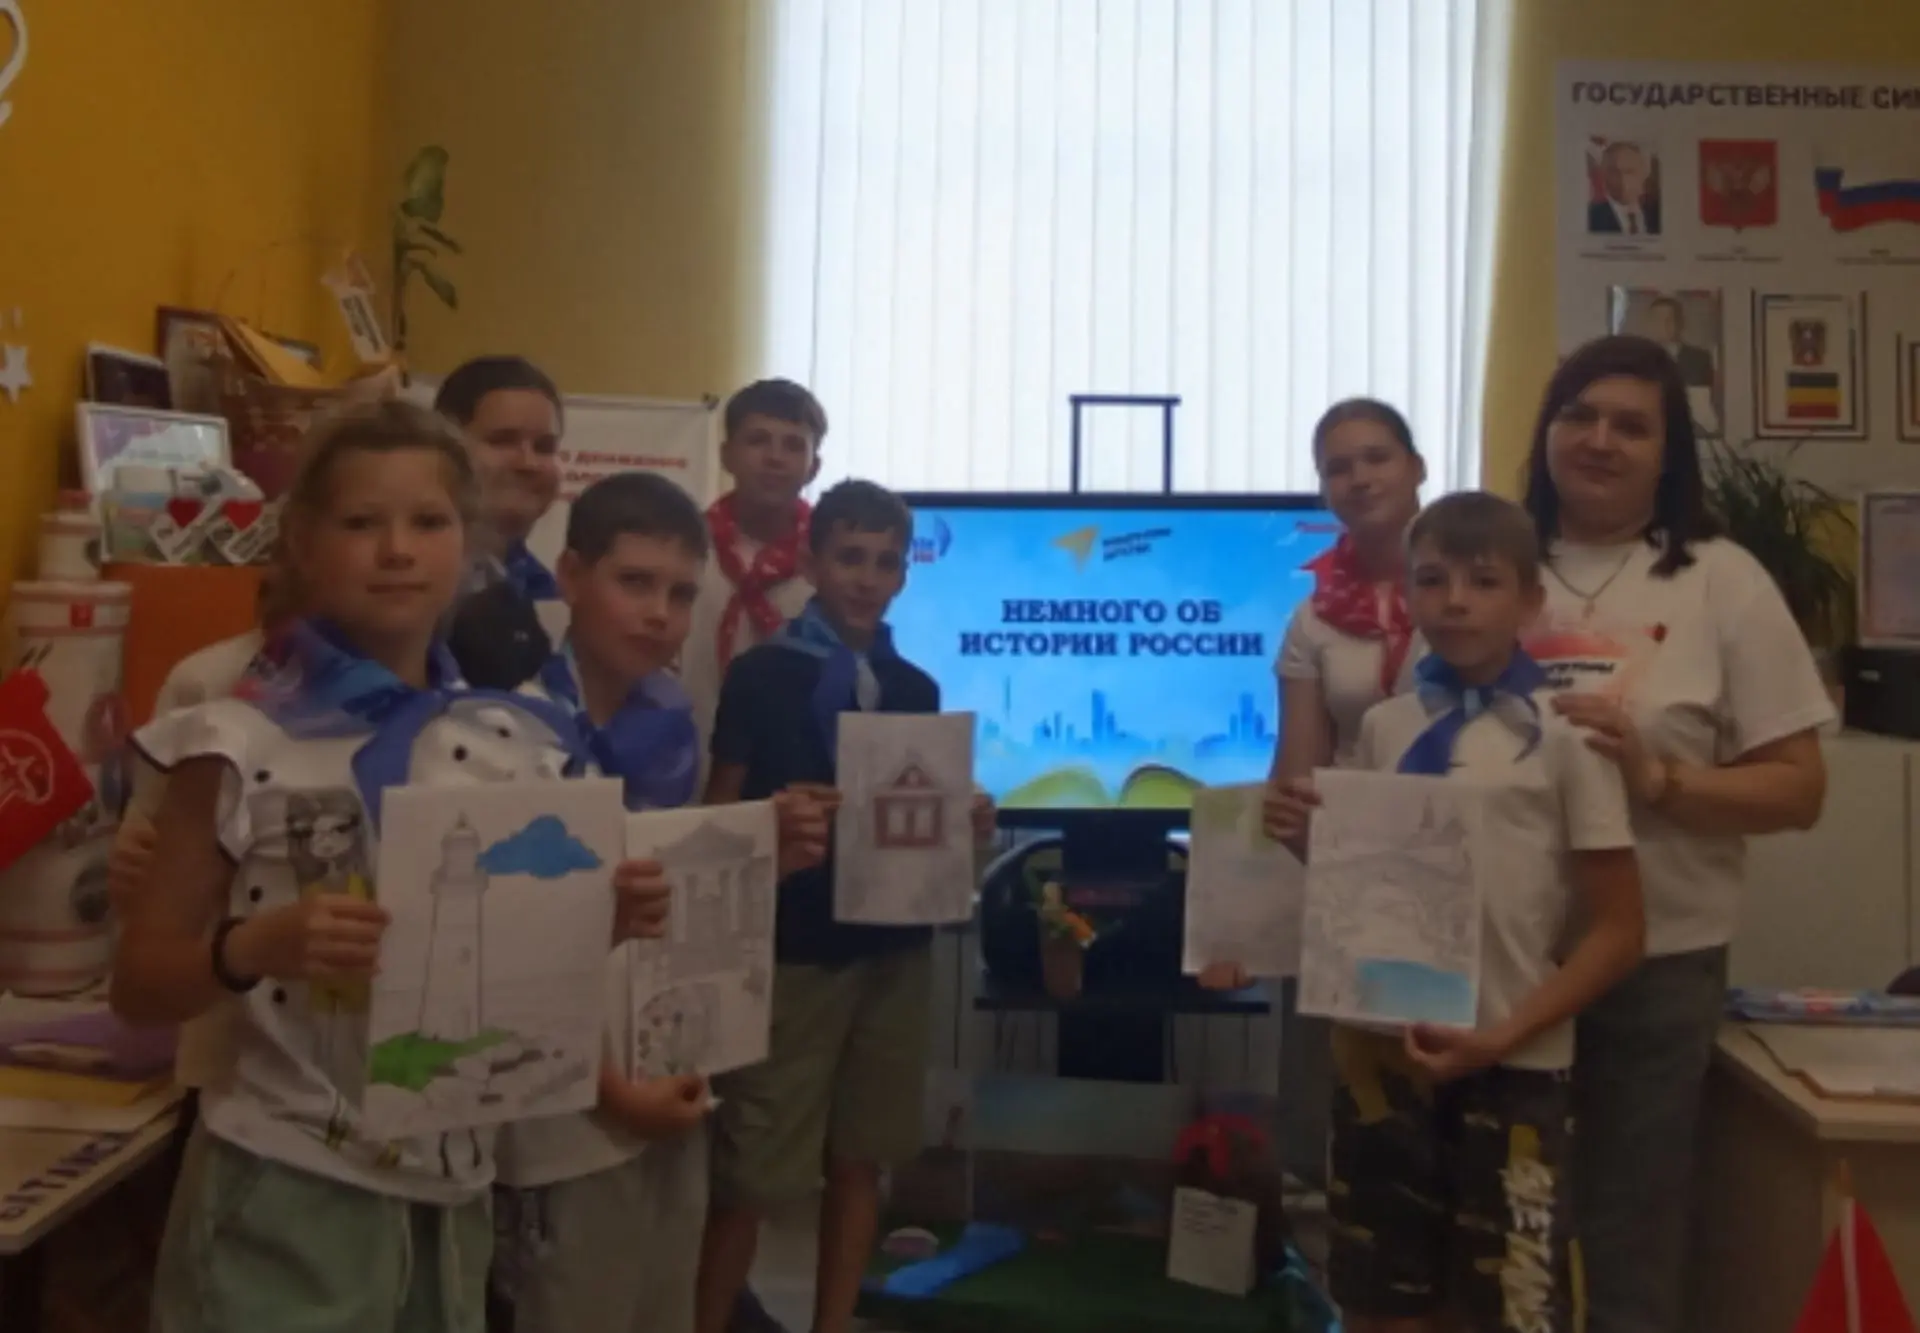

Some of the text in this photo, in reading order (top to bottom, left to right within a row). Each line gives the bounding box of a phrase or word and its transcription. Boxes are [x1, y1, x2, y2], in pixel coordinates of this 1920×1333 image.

[1572, 82, 1865, 110] ГОСУДАРСТВЕННЫЕ
[1001, 599, 1223, 624] НЕМНОГО ОБ
[959, 632, 1265, 656] ИСТОРИИ РОССИИ
